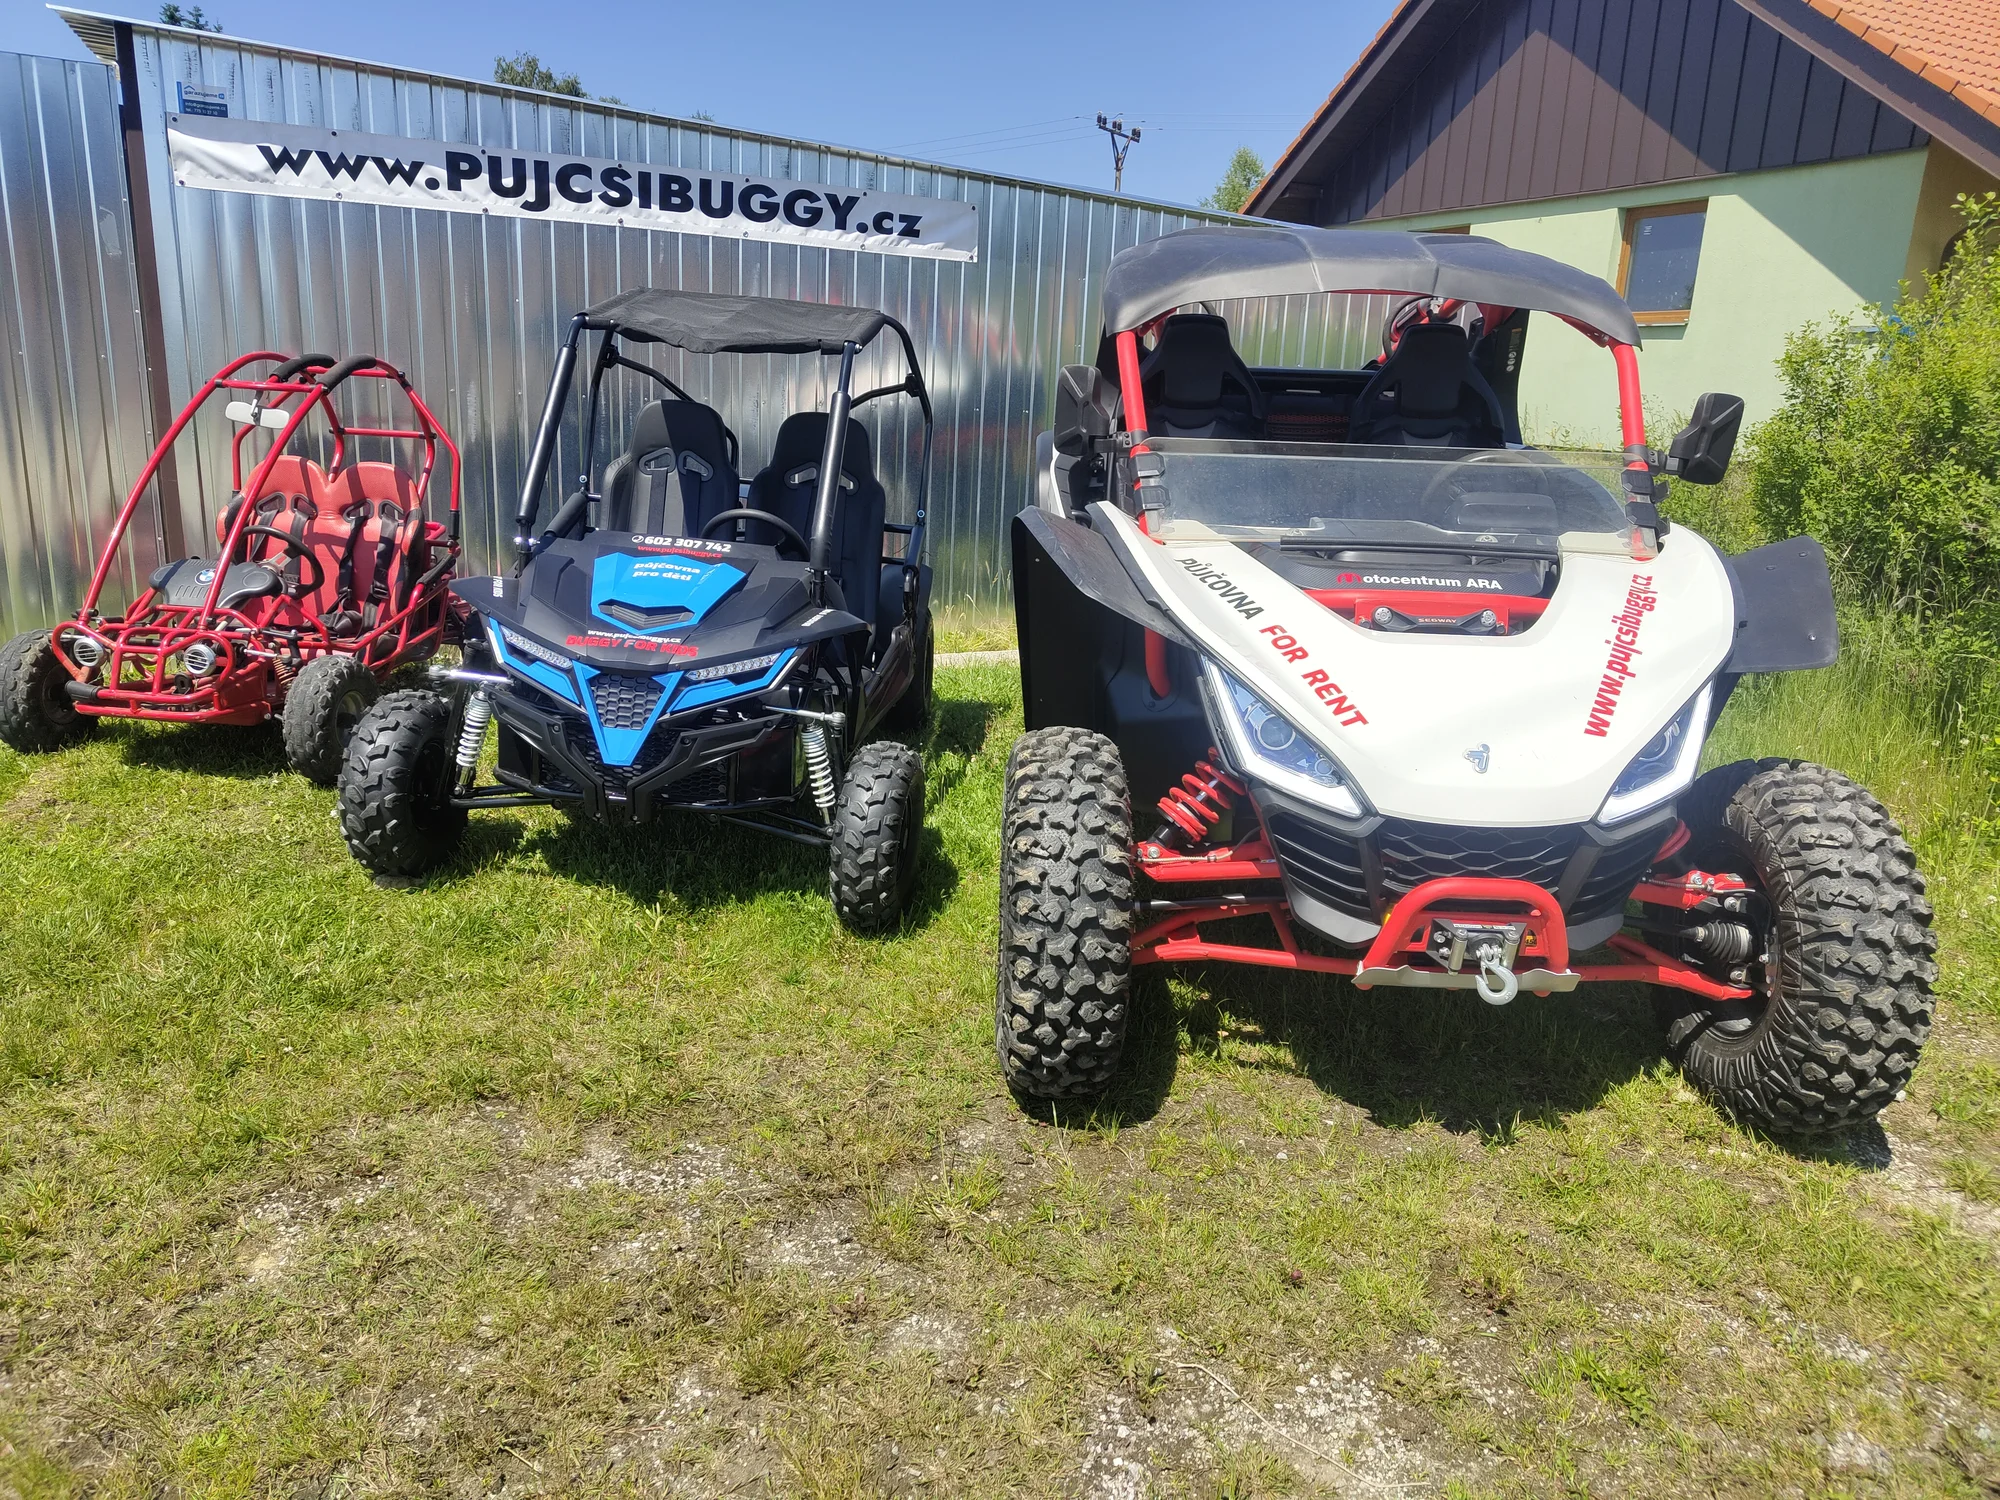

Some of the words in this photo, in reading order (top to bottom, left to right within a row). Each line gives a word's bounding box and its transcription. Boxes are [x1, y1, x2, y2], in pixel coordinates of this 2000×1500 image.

[256, 145, 923, 239] www.PUJCSIBUGGY.cz
[644, 536, 672, 546] 602
[674, 539, 702, 549] 307
[705, 542, 732, 553] 742
[1466, 578, 1503, 590] ARA
[565, 635, 623, 648] BUGGY
[623, 639, 658, 652] FOR
[660, 643, 700, 657] KIDS
[1174, 557, 1265, 620] PŮJČOVNA
[1259, 624, 1309, 664] FOR
[1301, 669, 1369, 727] RENT
[1583, 574, 1658, 738] www.pujcsibuggy.cz
